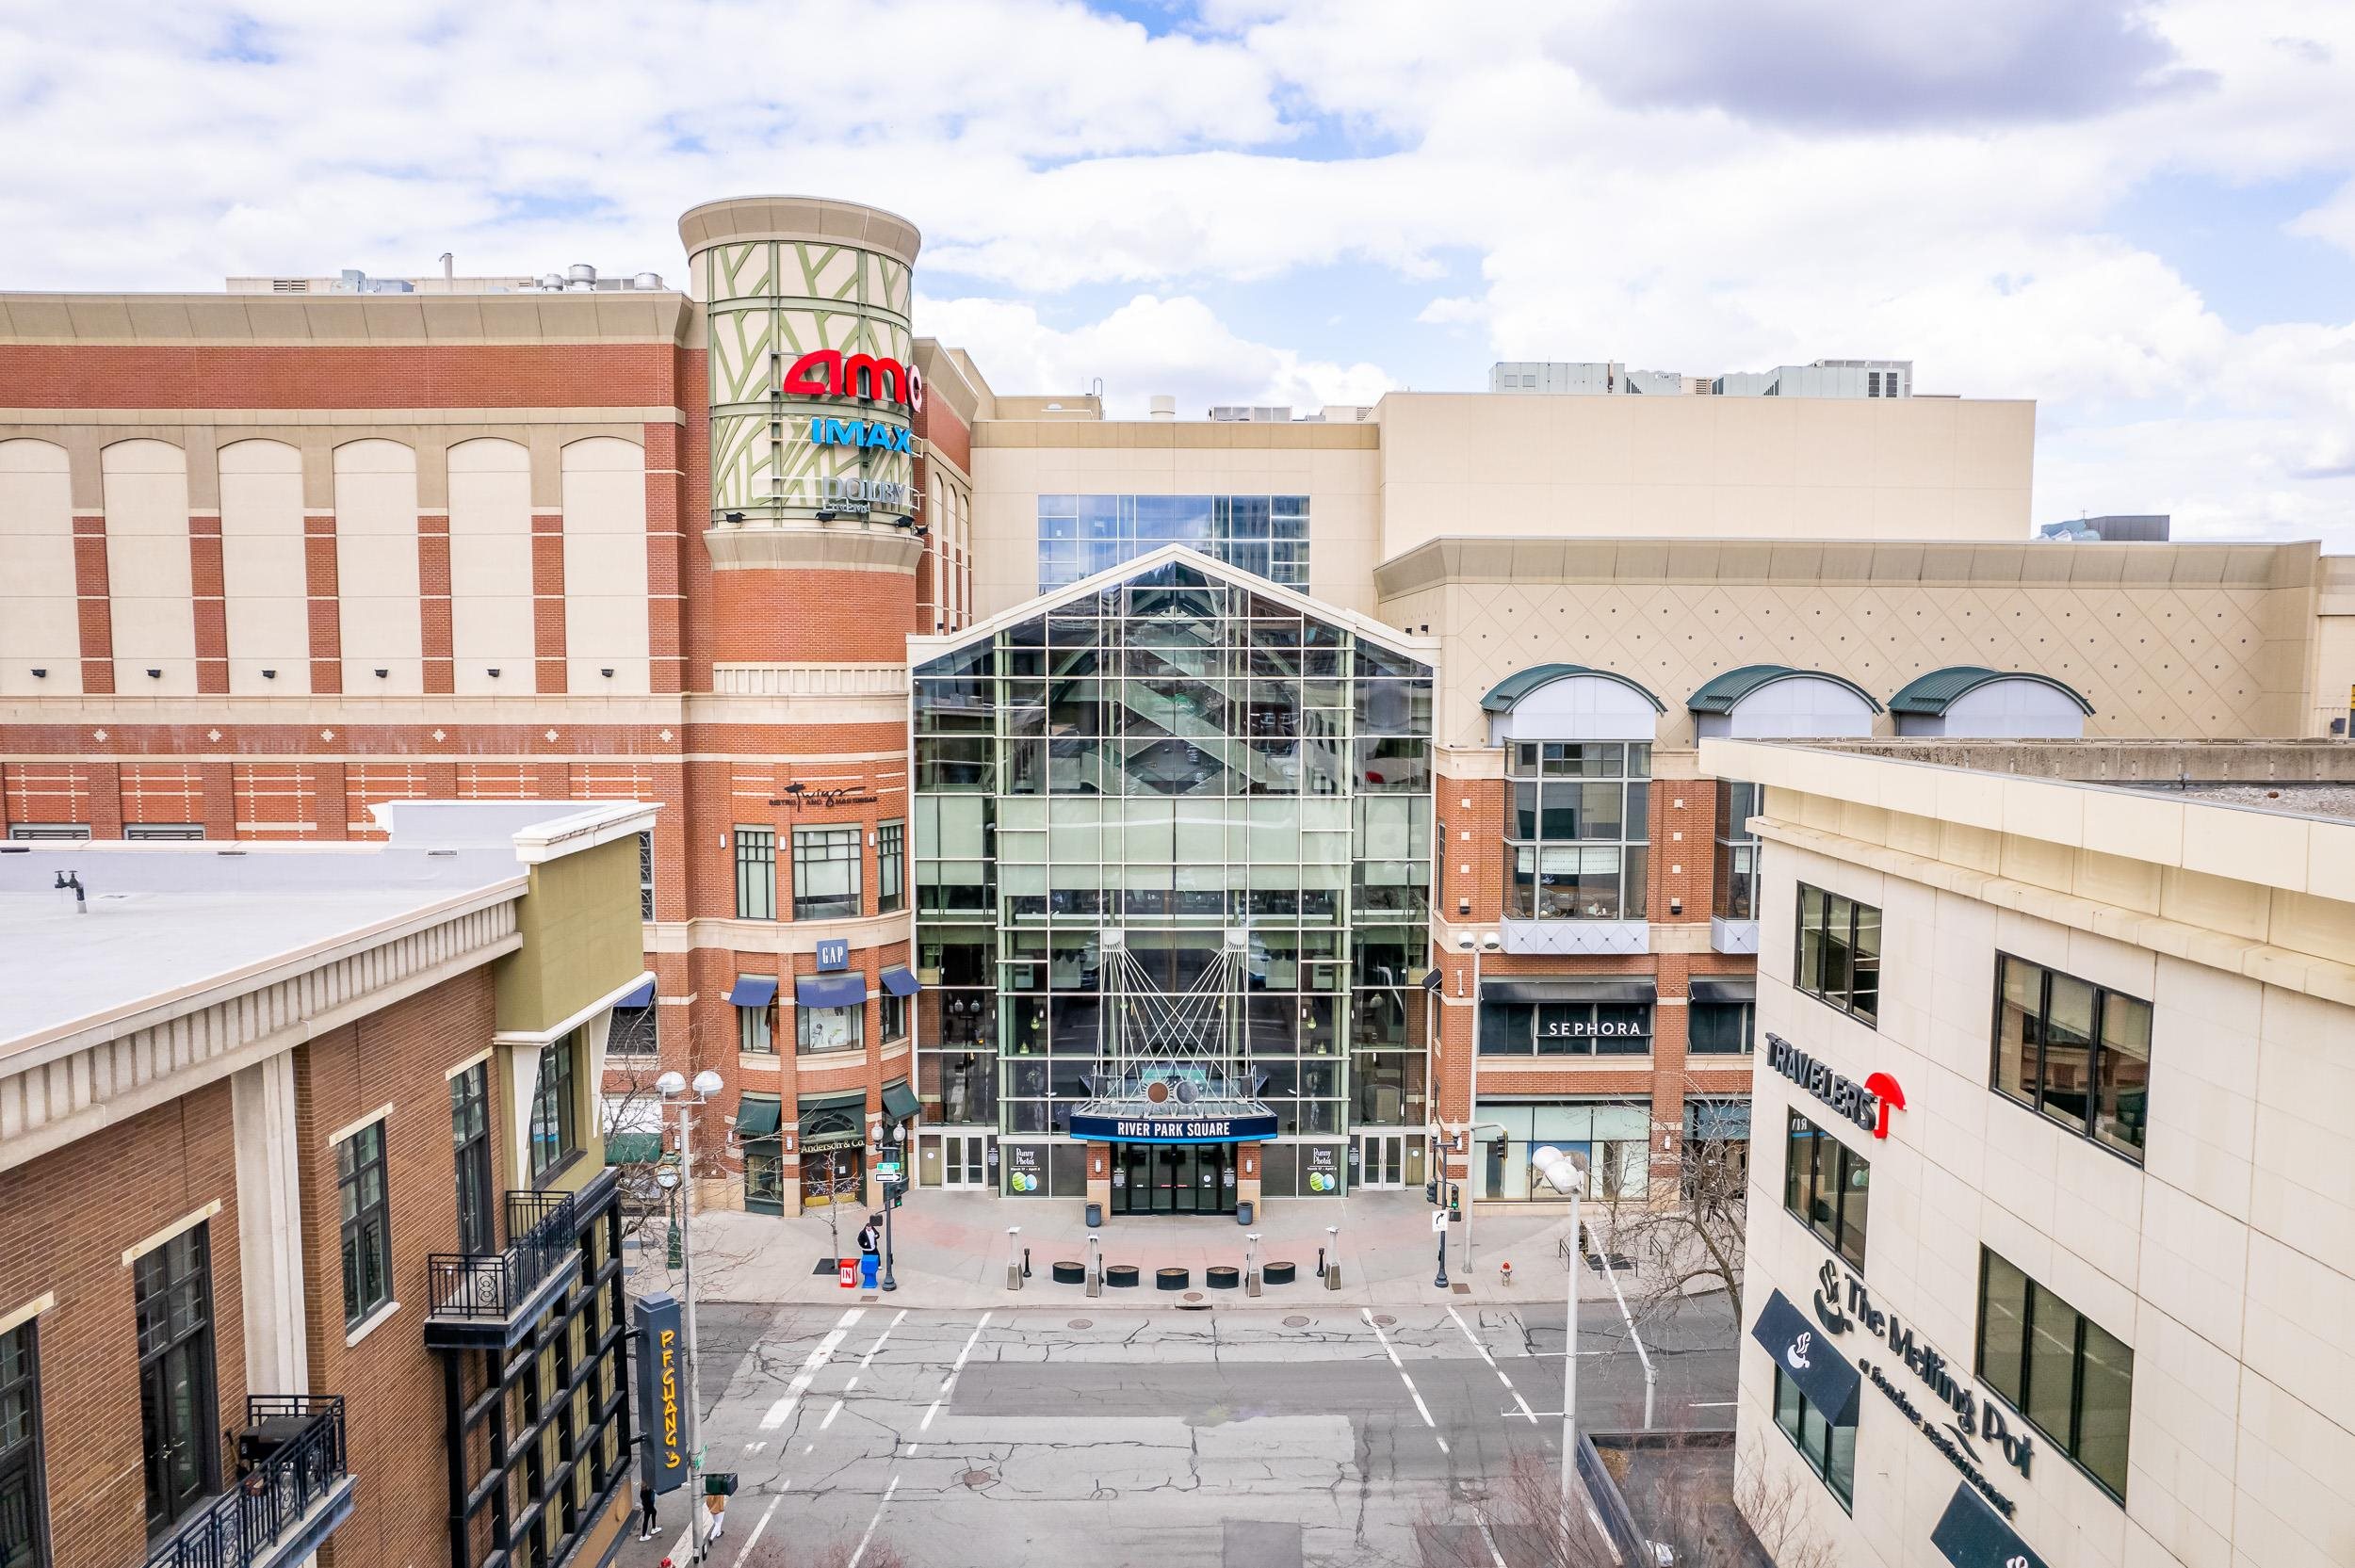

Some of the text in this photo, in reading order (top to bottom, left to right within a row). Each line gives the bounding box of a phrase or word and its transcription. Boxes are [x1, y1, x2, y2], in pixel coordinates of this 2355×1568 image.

[811, 417, 913, 454] IMAX
[822, 477, 905, 506] DOLBY
[822, 946, 843, 964] GAP
[1550, 1022, 1640, 1035] SEPHORA
[1765, 1032, 1877, 1131] TRAVELERS
[1117, 1122, 1230, 1137] RIVER PARK SQUARE
[801, 1141, 843, 1153] Anderson
[843, 1269, 851, 1279] IN
[1844, 1272, 2035, 1479] The Melting Pot
